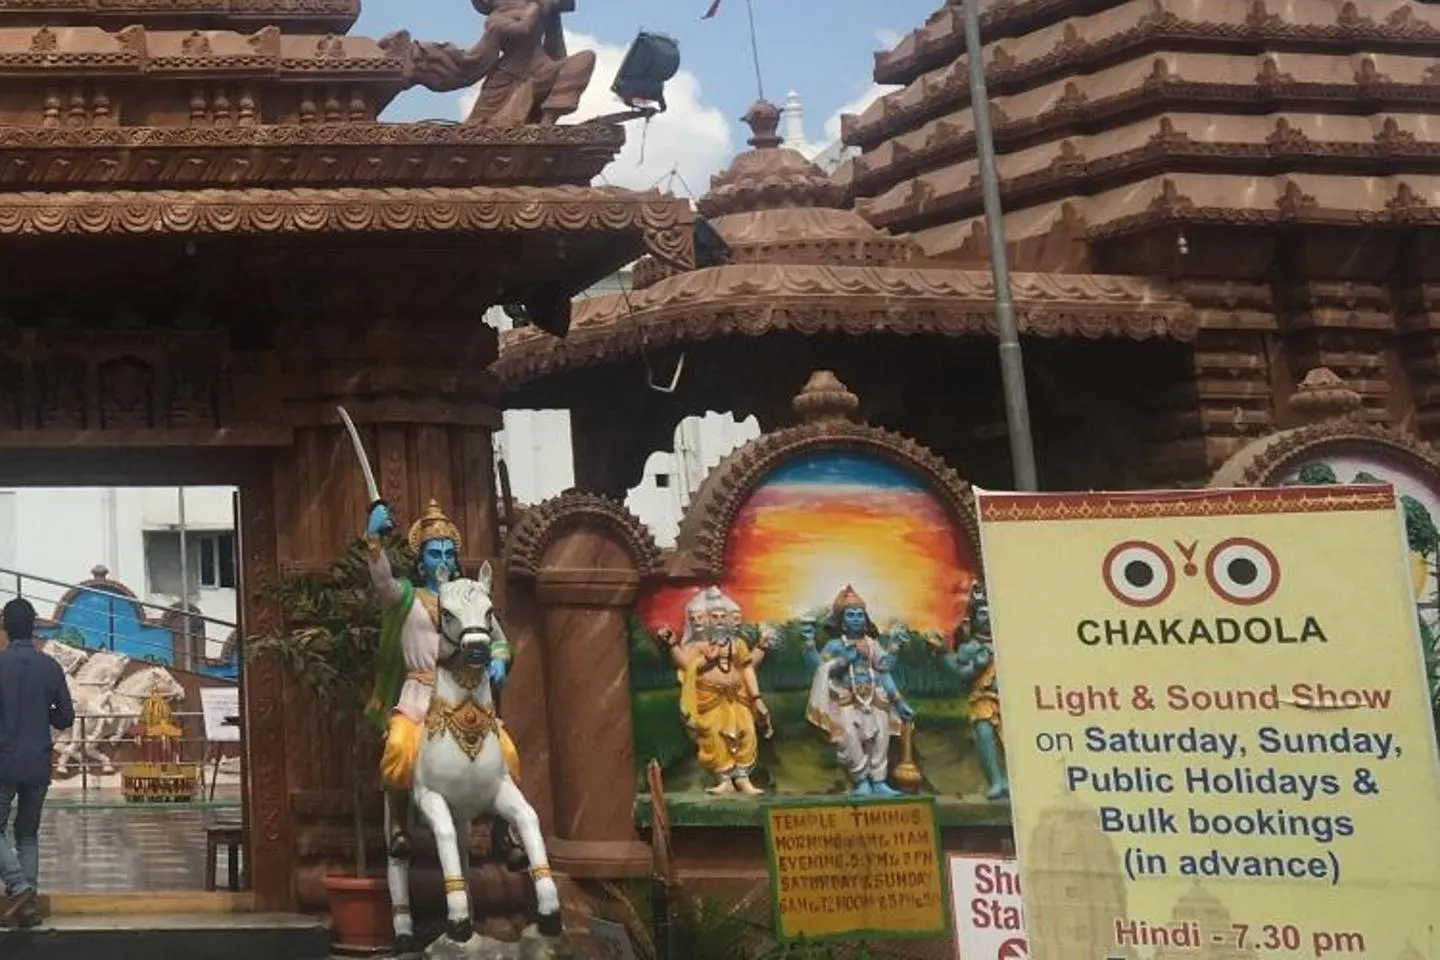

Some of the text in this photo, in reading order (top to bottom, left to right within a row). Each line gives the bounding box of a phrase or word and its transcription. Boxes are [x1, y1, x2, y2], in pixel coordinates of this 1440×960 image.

[1076, 616, 1328, 646] CHAKADOLA
[1034, 683, 1392, 716] Light & Sound Show
[1035, 726, 1404, 760] on Saturday, Sunday,
[1067, 765, 1380, 800] Public Holidays &
[772, 811, 837, 831] TEMPLE
[1100, 806, 1354, 842] Bulk bookings
[1123, 848, 1341, 884] (in advance)
[971, 898, 1025, 930] Sta
[1115, 919, 1200, 949] Hindi
[1231, 923, 1300, 952] 7.30
[1313, 928, 1365, 958] pm
